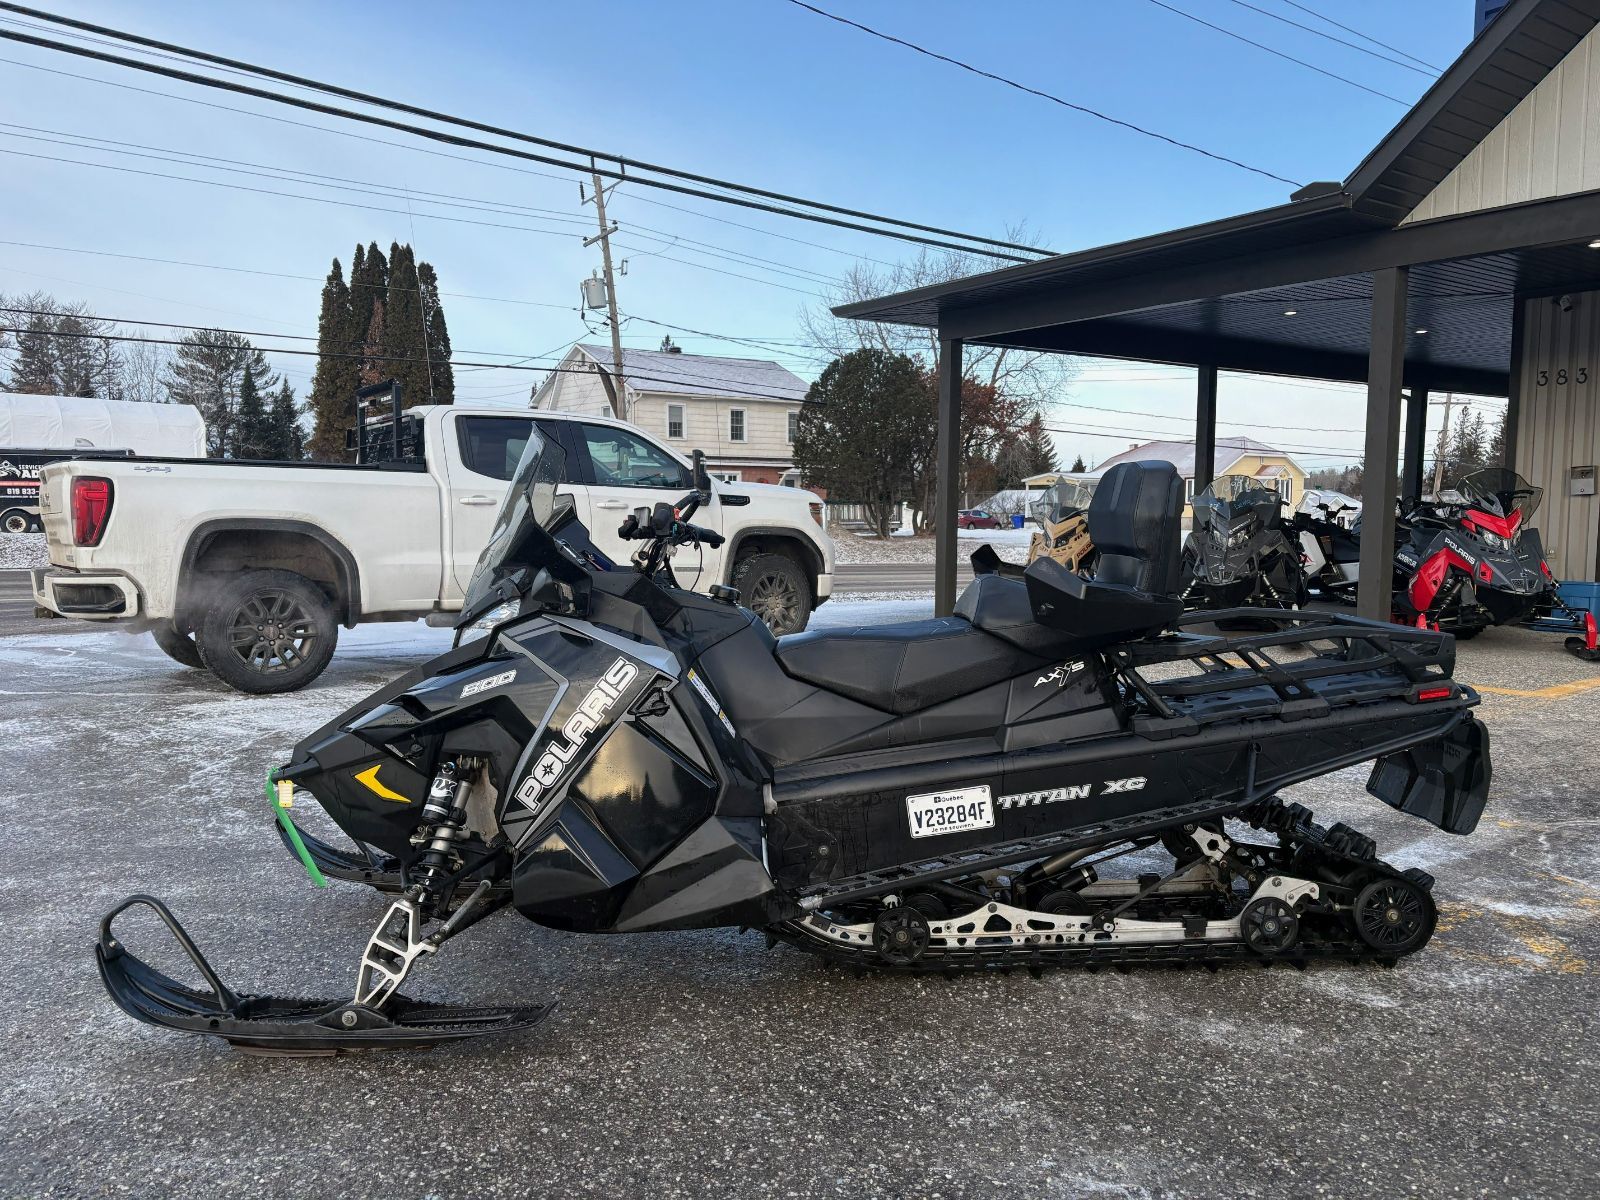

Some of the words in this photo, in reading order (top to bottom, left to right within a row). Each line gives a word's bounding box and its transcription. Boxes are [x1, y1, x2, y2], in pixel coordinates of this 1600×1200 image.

[1537, 367, 1588, 387] 383
[1444, 537, 1476, 565] POLARIS
[1033, 660, 1085, 688] AXYS
[514, 656, 639, 813] POLARIS
[997, 783, 1092, 810] TITAN
[1100, 776, 1148, 796] XC
[914, 801, 987, 829] V23284F
